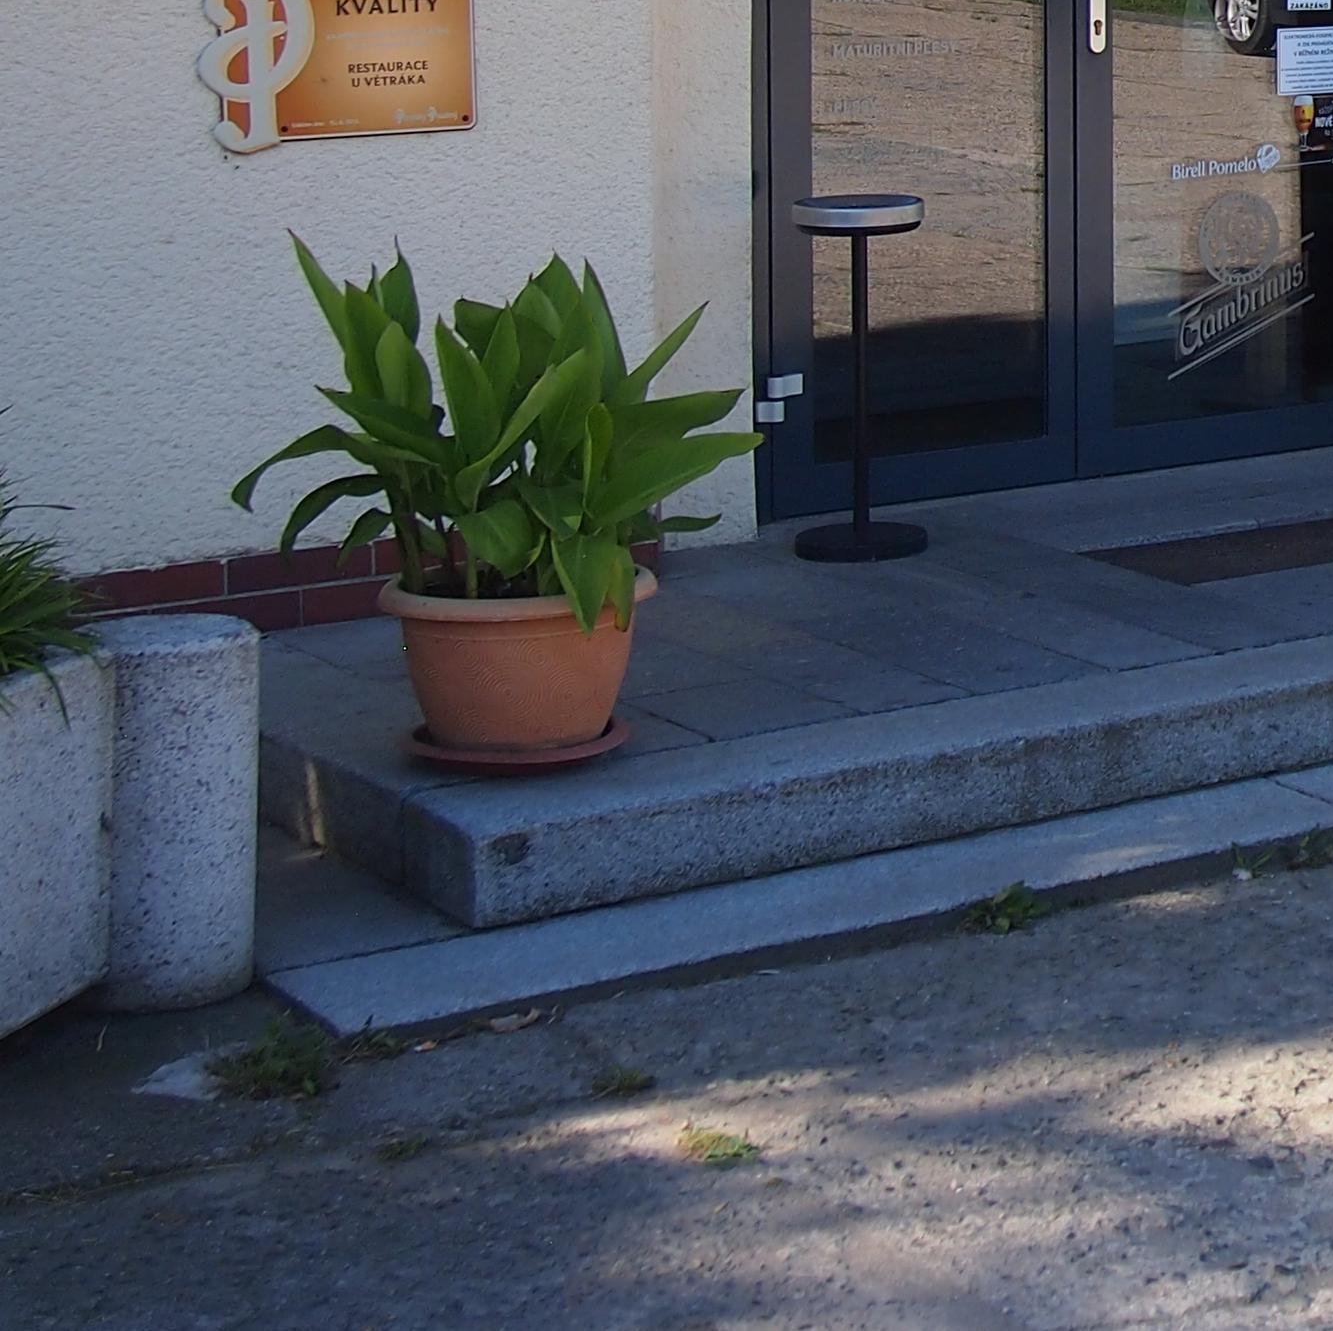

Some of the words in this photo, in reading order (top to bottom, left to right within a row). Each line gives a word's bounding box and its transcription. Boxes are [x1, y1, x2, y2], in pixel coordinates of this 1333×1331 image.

[347, 59, 429, 75] RESTAURACE
[351, 77, 361, 88] U
[364, 73, 427, 86] VĚTRÁKA
[1171, 162, 1206, 181] Birell
[1208, 156, 1257, 176] Pomelo
[1180, 260, 1306, 357] Gambrinus
